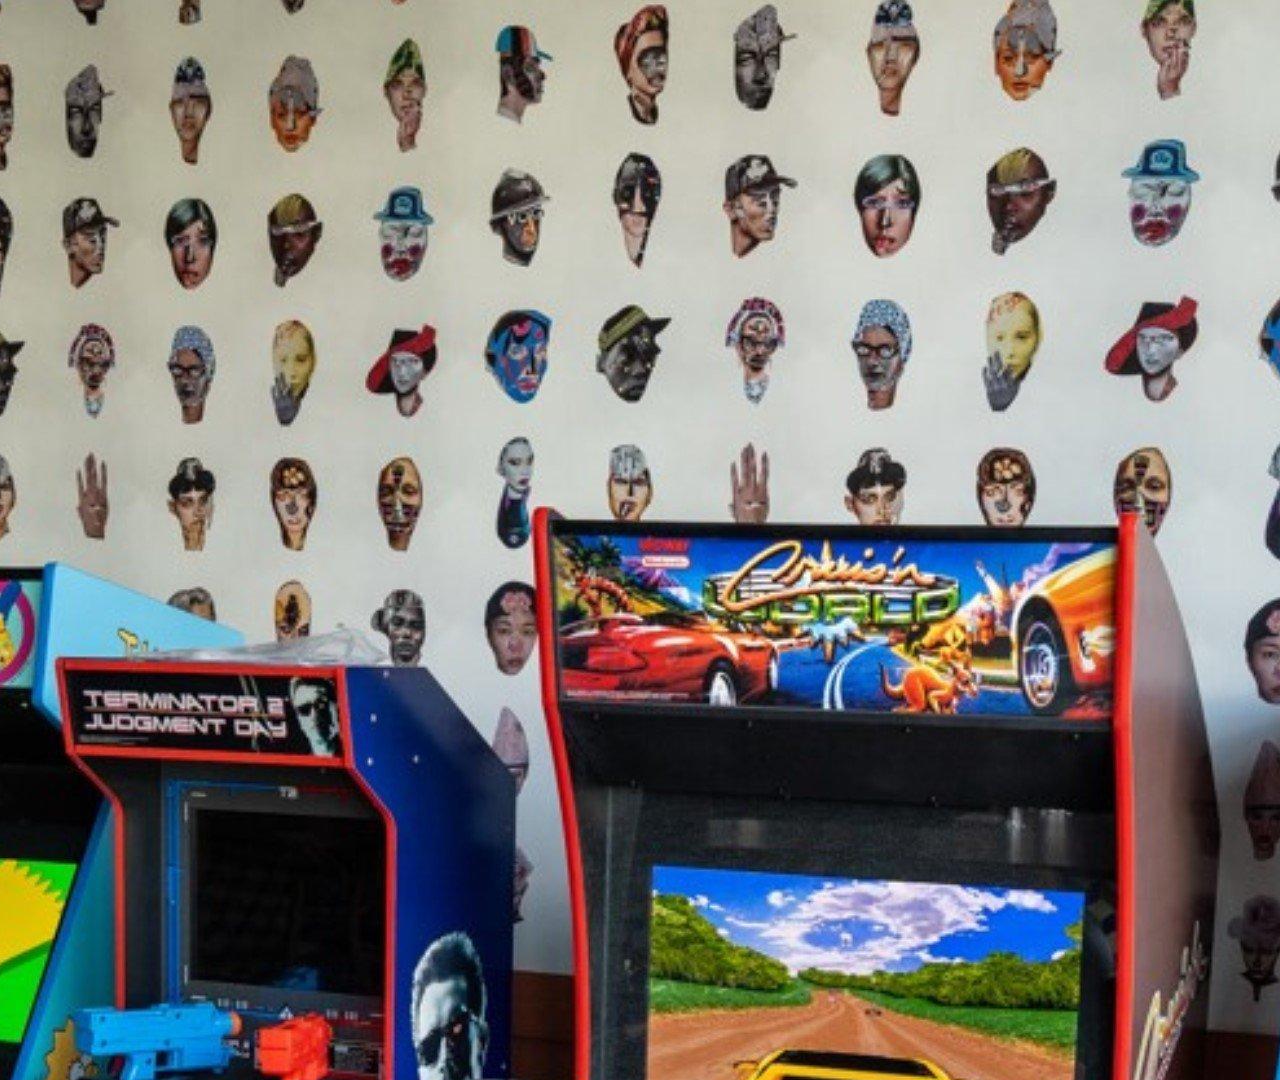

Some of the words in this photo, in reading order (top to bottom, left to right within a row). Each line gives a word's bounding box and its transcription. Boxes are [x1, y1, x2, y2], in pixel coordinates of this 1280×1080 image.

[82, 688, 259, 714] TERMINATOR
[267, 697, 286, 716] 2
[84, 712, 226, 736] JUDGMENT
[233, 717, 287, 739] DAY
